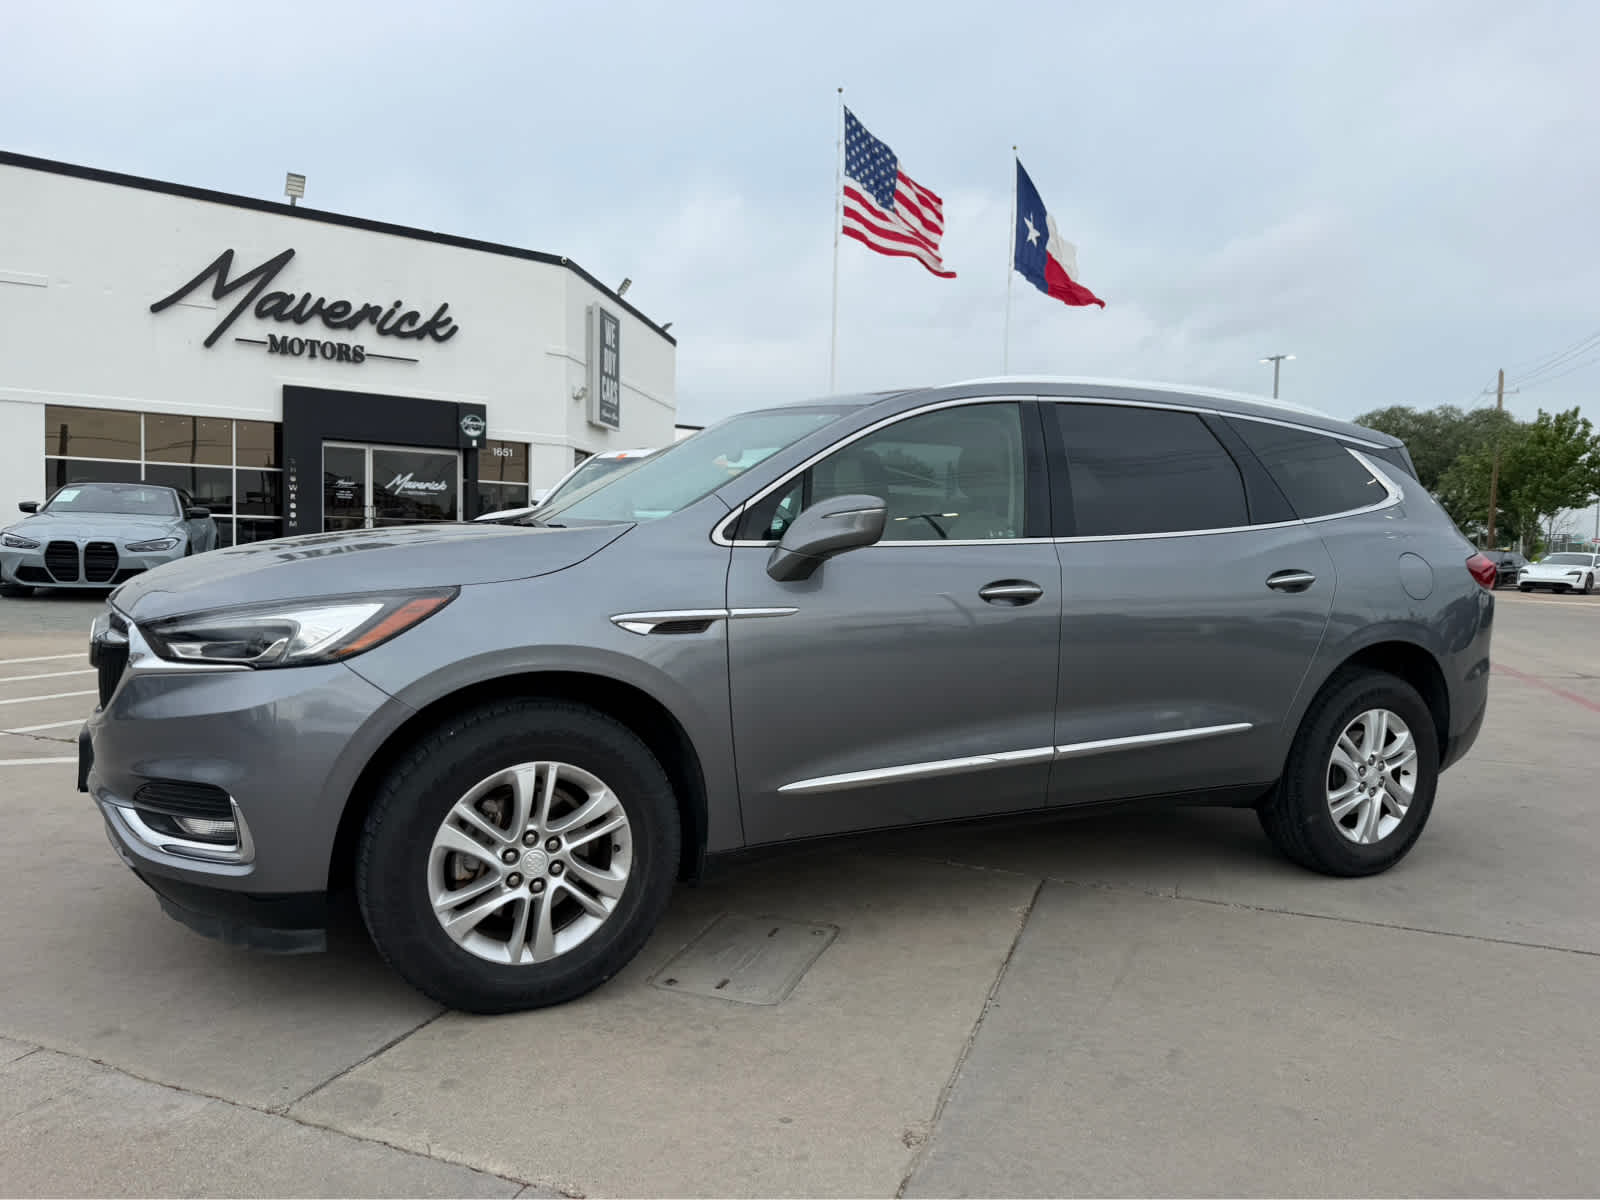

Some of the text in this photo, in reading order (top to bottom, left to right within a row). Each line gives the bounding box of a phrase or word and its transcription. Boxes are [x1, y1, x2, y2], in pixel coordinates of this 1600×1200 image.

[150, 248, 458, 347] Maverick
[604, 319, 616, 348] WE
[267, 334, 366, 363] MOTORS
[603, 347, 616, 377] BUY
[602, 376, 618, 405] CARS
[493, 447, 513, 457] 1651
[385, 473, 447, 495] Maverick
